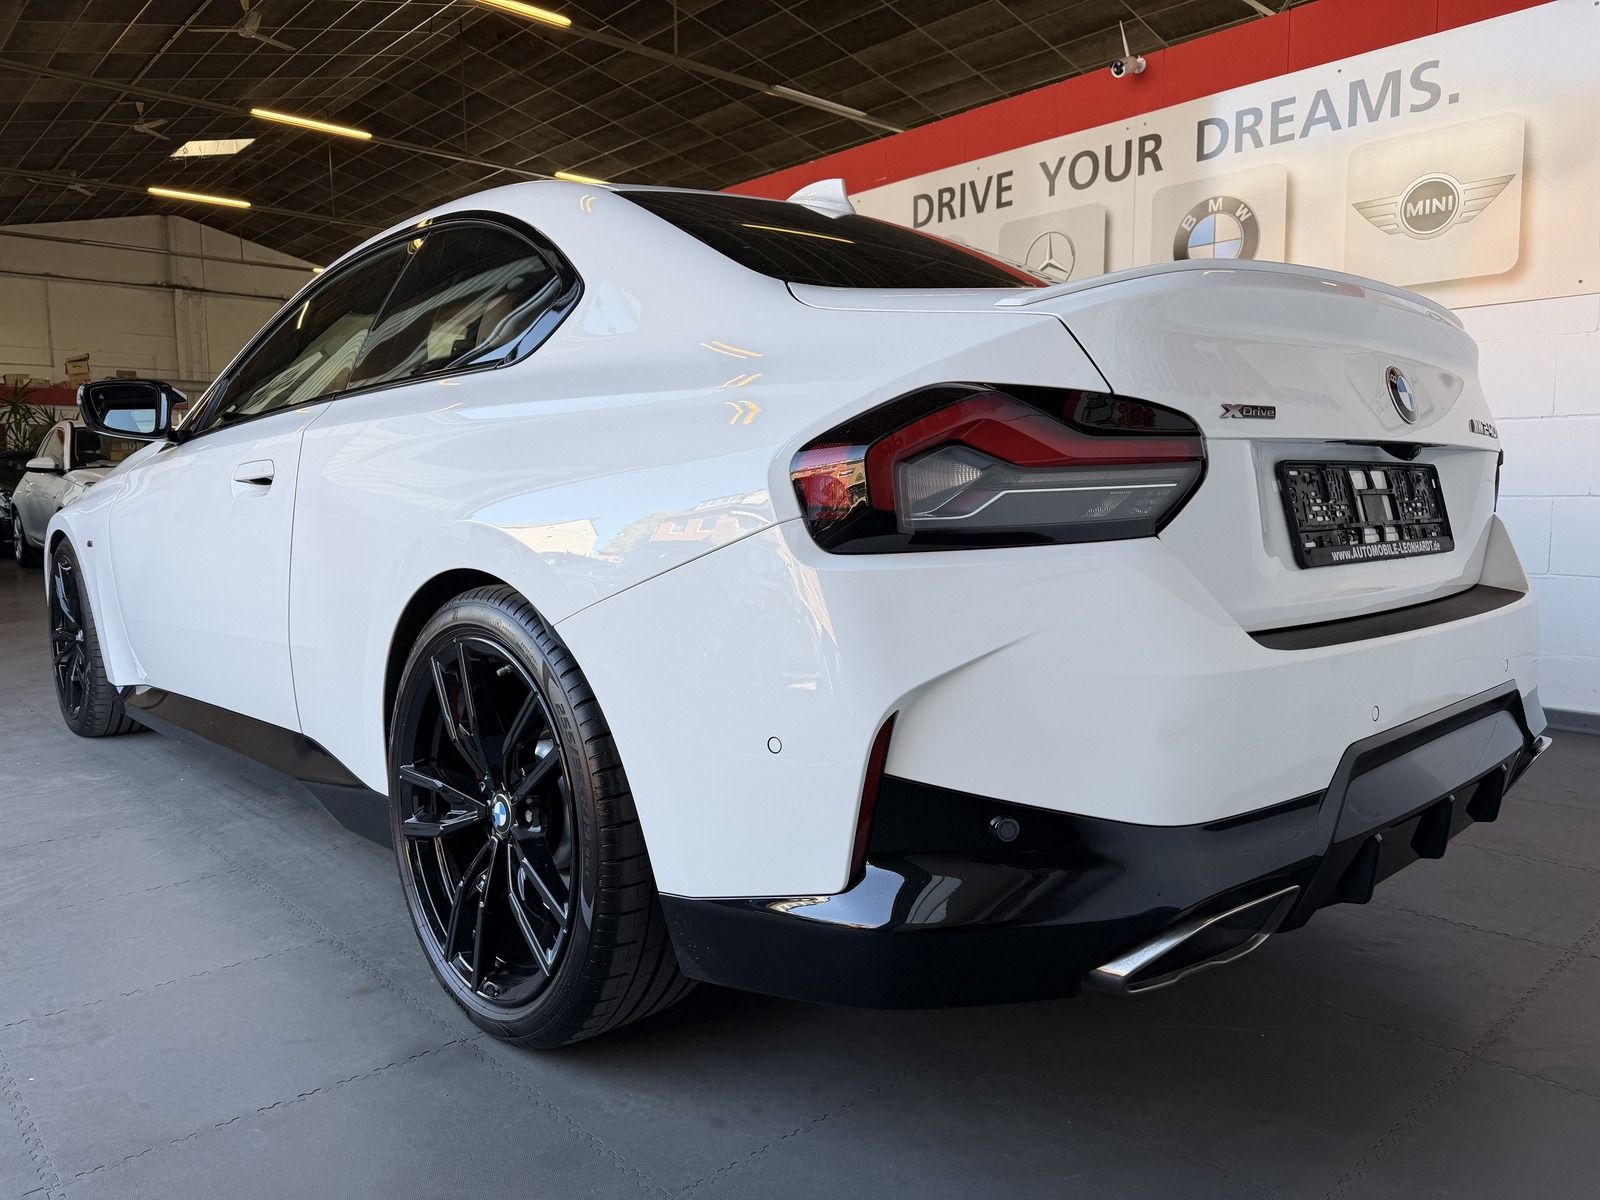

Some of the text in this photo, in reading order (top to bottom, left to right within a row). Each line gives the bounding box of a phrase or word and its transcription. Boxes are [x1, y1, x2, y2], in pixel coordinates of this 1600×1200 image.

[912, 59, 1460, 229] DRIVE YOUR DREAMS.
[1181, 197, 1252, 231] BMW
[1406, 195, 1454, 218] MINI
[1331, 540, 1441, 561] www.AUTOMOBILE-LEONHARDT.de
